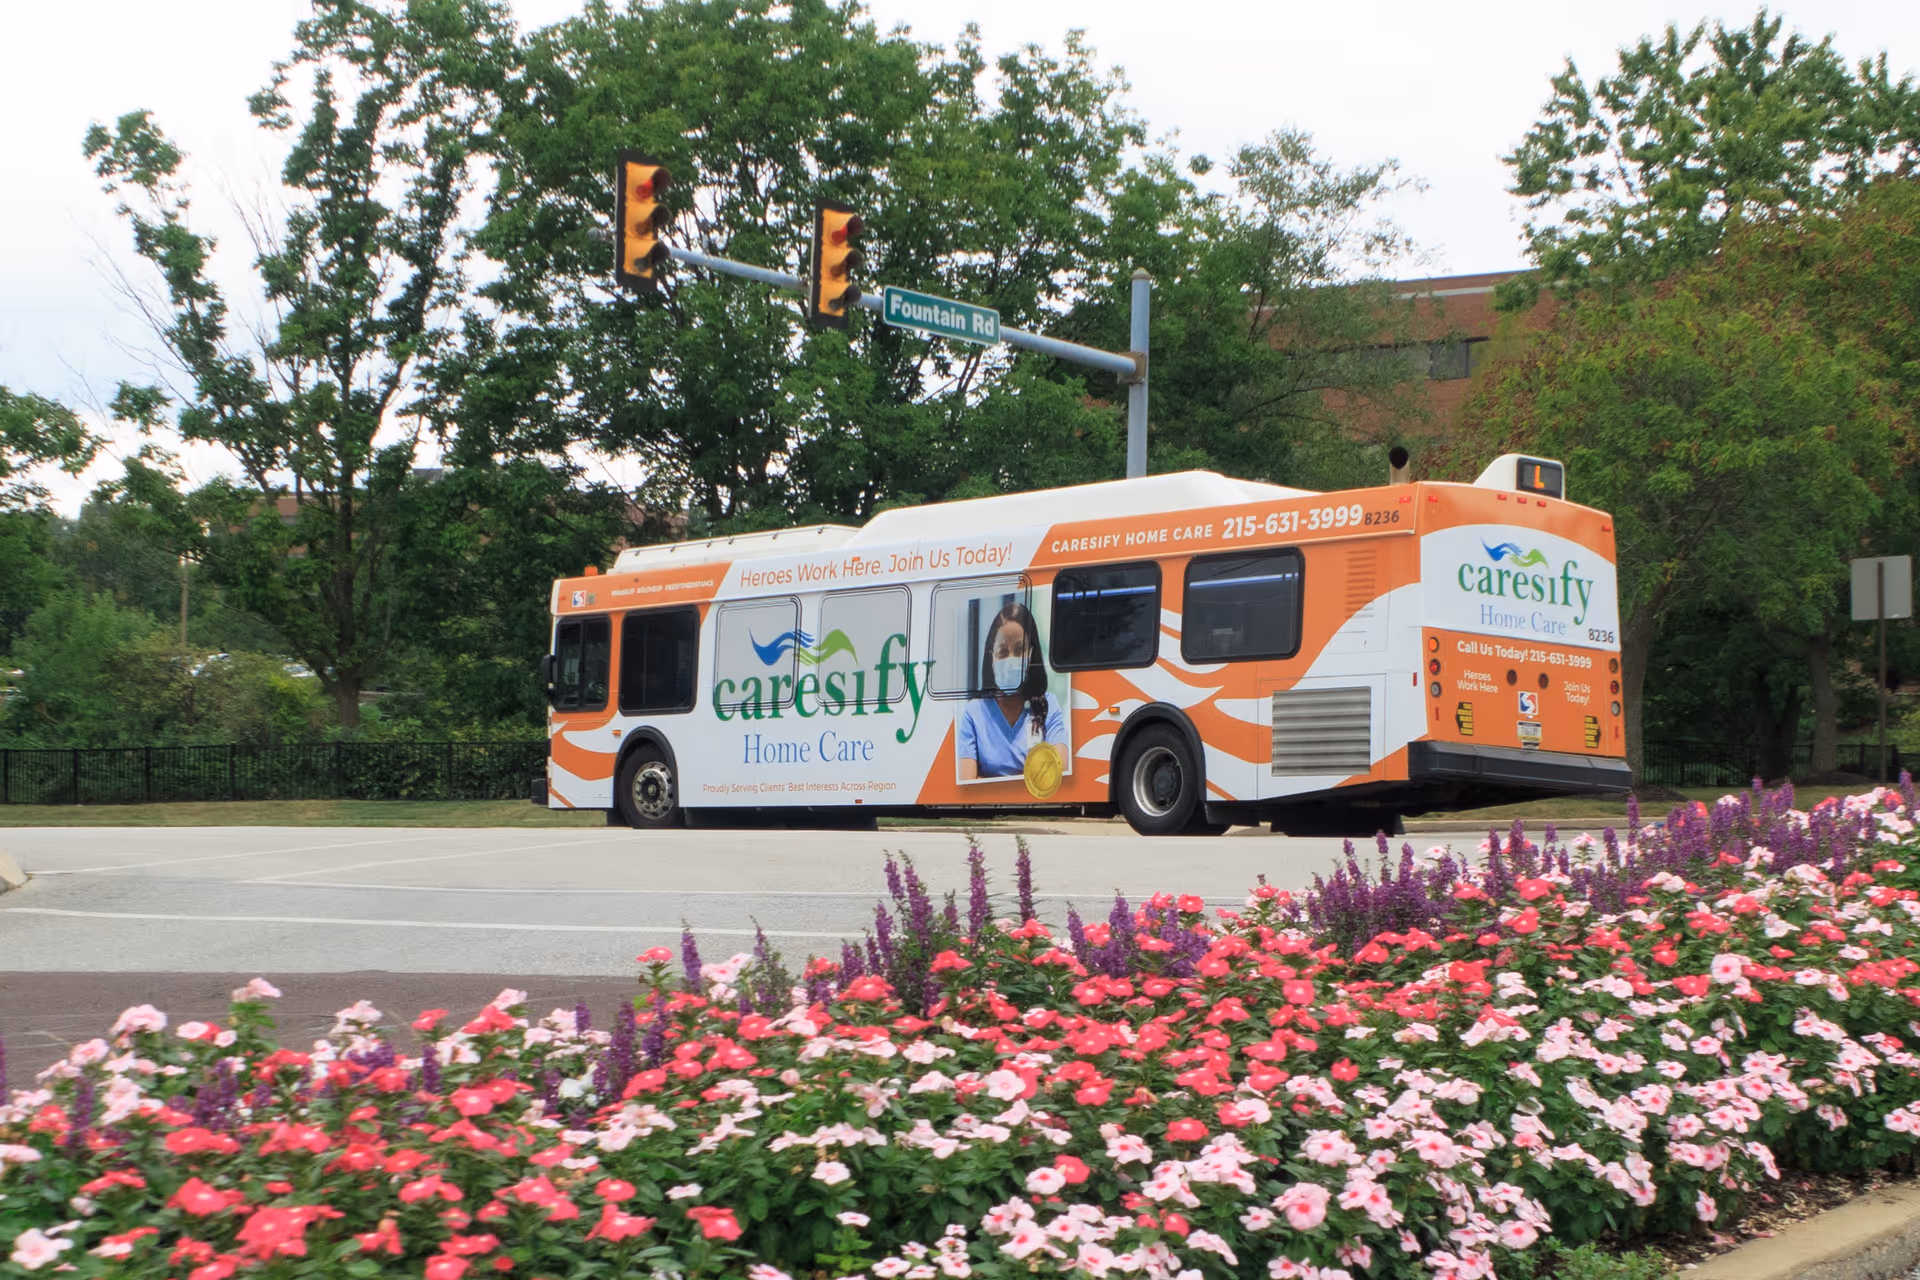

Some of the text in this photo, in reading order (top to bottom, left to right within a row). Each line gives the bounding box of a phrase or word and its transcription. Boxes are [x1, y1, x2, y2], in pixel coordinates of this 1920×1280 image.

[890, 294, 994, 336] Fountain Rd
[1534, 465, 1544, 489] L
[1051, 503, 1363, 554] CARESIFY HOME CARE 215-631-3999
[1364, 509, 1400, 526] 8236
[740, 542, 1012, 588] Heroes Work Here. Join Us Today!
[1458, 560, 1594, 625] caresify
[1480, 604, 1566, 635] Home Care
[1588, 628, 1614, 644] 8236
[1457, 640, 1592, 668] Call Us Today! 215-631-3999
[714, 633, 936, 744] caresify
[1457, 679, 1498, 693] Work Here
[1463, 669, 1492, 681] Heroes
[1564, 681, 1591, 693] Join Us
[744, 730, 874, 764] Home Care
[703, 784, 730, 794] Proudly
[732, 784, 758, 794] Serving
[788, 783, 804, 792] Best
[806, 782, 839, 791] Interests
[840, 781, 866, 791] Across
[868, 780, 896, 792] Region
